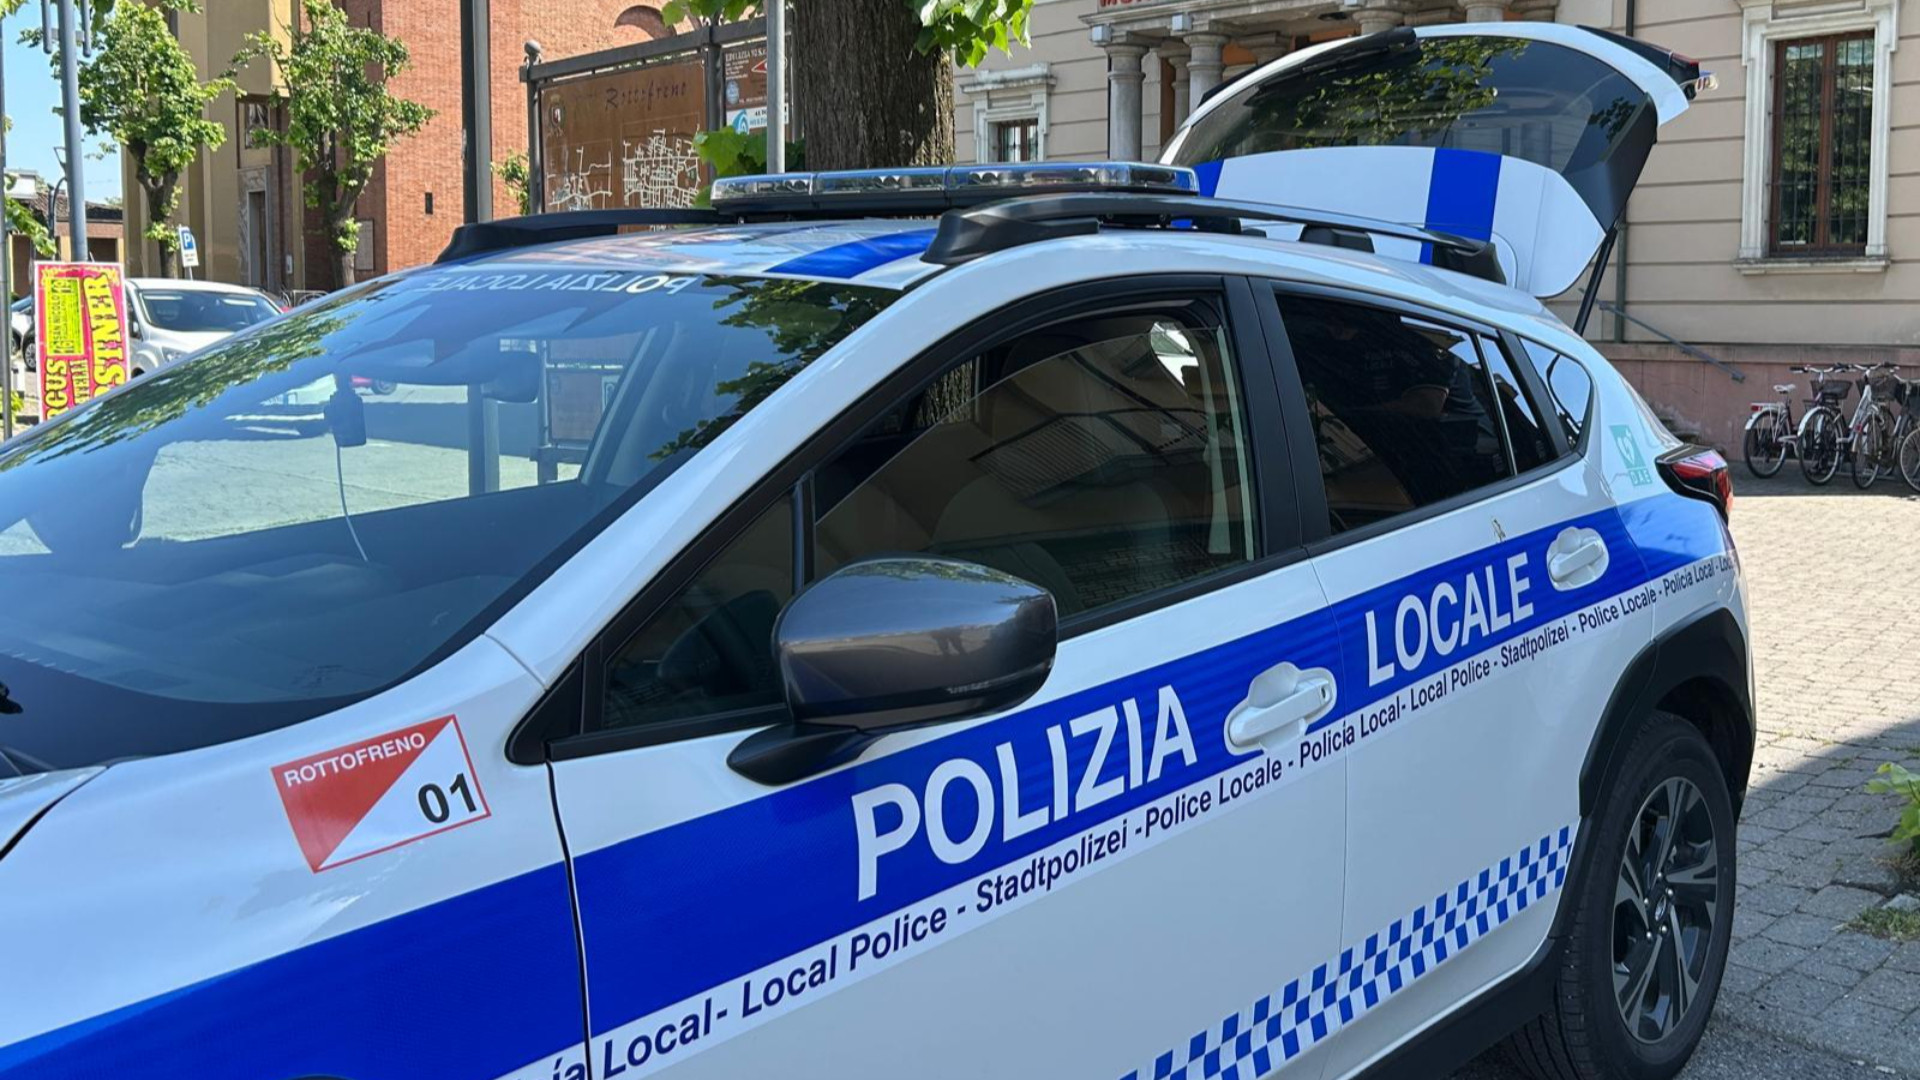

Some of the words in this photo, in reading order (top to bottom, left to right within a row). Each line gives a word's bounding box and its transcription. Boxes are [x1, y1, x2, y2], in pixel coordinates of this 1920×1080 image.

[183, 232, 192, 248] P
[83, 274, 126, 398] STNER
[45, 358, 69, 420] RCUS
[69, 358, 91, 405] ATELLI
[1631, 468, 1651, 485] DAE
[851, 684, 1198, 902] POLIZIA
[1365, 552, 1534, 688] LOCALE
[283, 732, 426, 788] ROTTOFRENO
[417, 772, 477, 824] 01
[603, 997, 728, 1080] Local-
[741, 944, 838, 1019] Local
[850, 907, 947, 972] Police
[976, 819, 1128, 914] Stadtpolizei
[1218, 758, 1282, 805] Locale
[1300, 720, 1355, 769] Policía
[1410, 672, 1447, 712] Local
[1451, 659, 1490, 692] Police
[1501, 620, 1570, 668] Stadtpolizei
[1578, 603, 1620, 633] Police
[1619, 586, 1657, 616] Locale
[1662, 567, 1694, 597] Policía
[1693, 558, 1715, 583] Local
